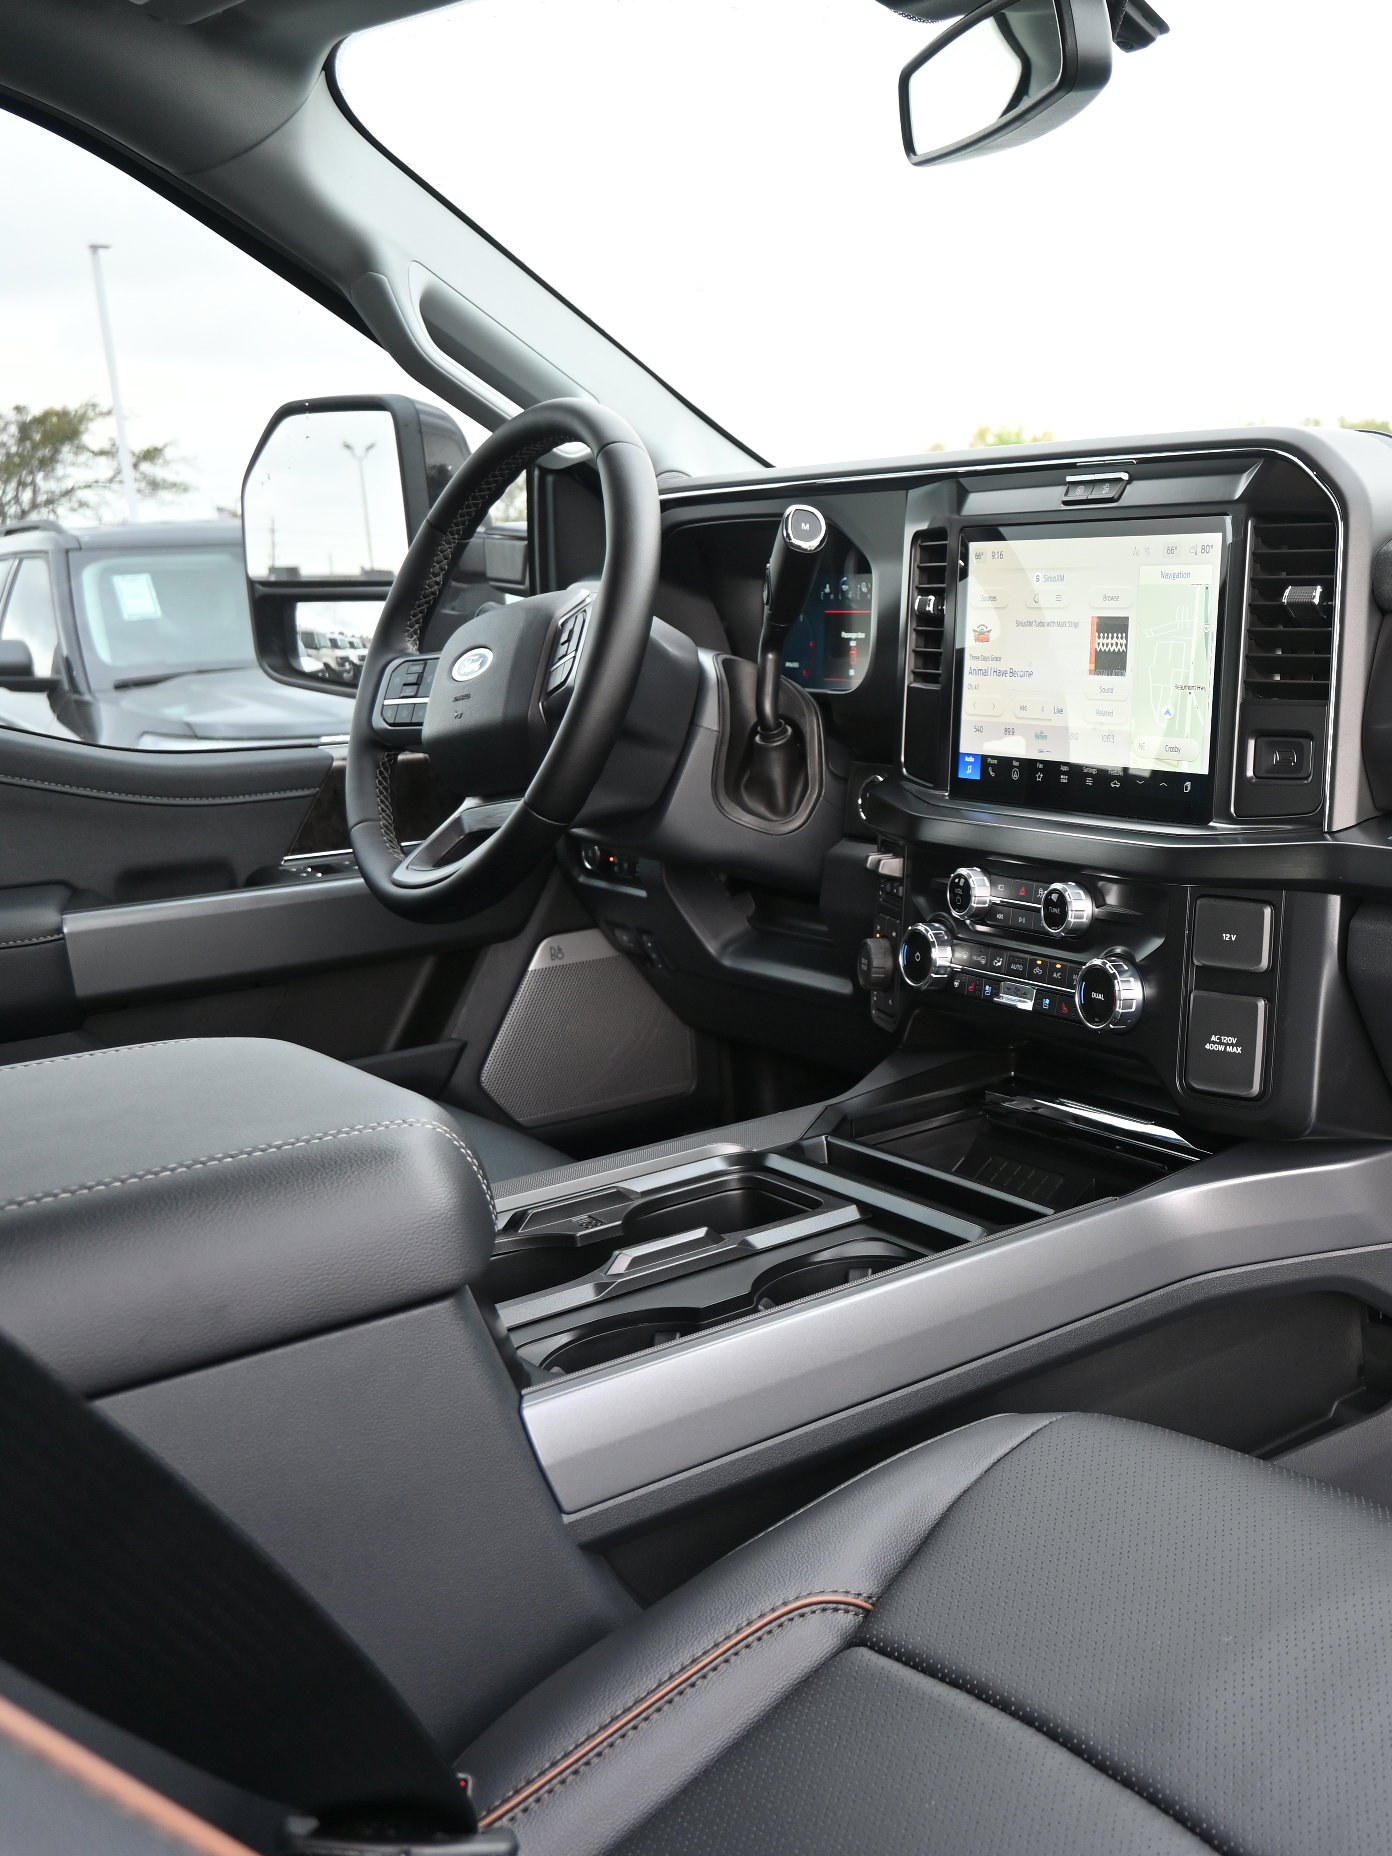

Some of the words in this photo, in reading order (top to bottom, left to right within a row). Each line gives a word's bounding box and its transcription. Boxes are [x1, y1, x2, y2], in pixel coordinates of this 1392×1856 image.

[801, 523, 810, 531] M
[991, 550, 1004, 560] 9:16
[1043, 574, 1065, 583] SiriusXM
[1160, 571, 1191, 580] Navigation
[1103, 594, 1120, 602] Browse
[968, 667, 989, 677] Animal
[993, 668, 1008, 678] Have
[1009, 668, 1033, 678] Become
[1099, 686, 1114, 694] Sound
[1053, 706, 1064, 715] Live
[1096, 709, 1113, 717] Related
[1164, 744, 1181, 754] Crosby
[1048, 906, 1060, 915] TUNE
[1010, 963, 1024, 972] AUTO
[1091, 992, 1105, 1001] DUAL
[1210, 1034, 1220, 1042] AC
[1221, 1036, 1237, 1044] 120V
[1205, 1043, 1225, 1052] 400W
[1226, 1045, 1242, 1054] MAX
